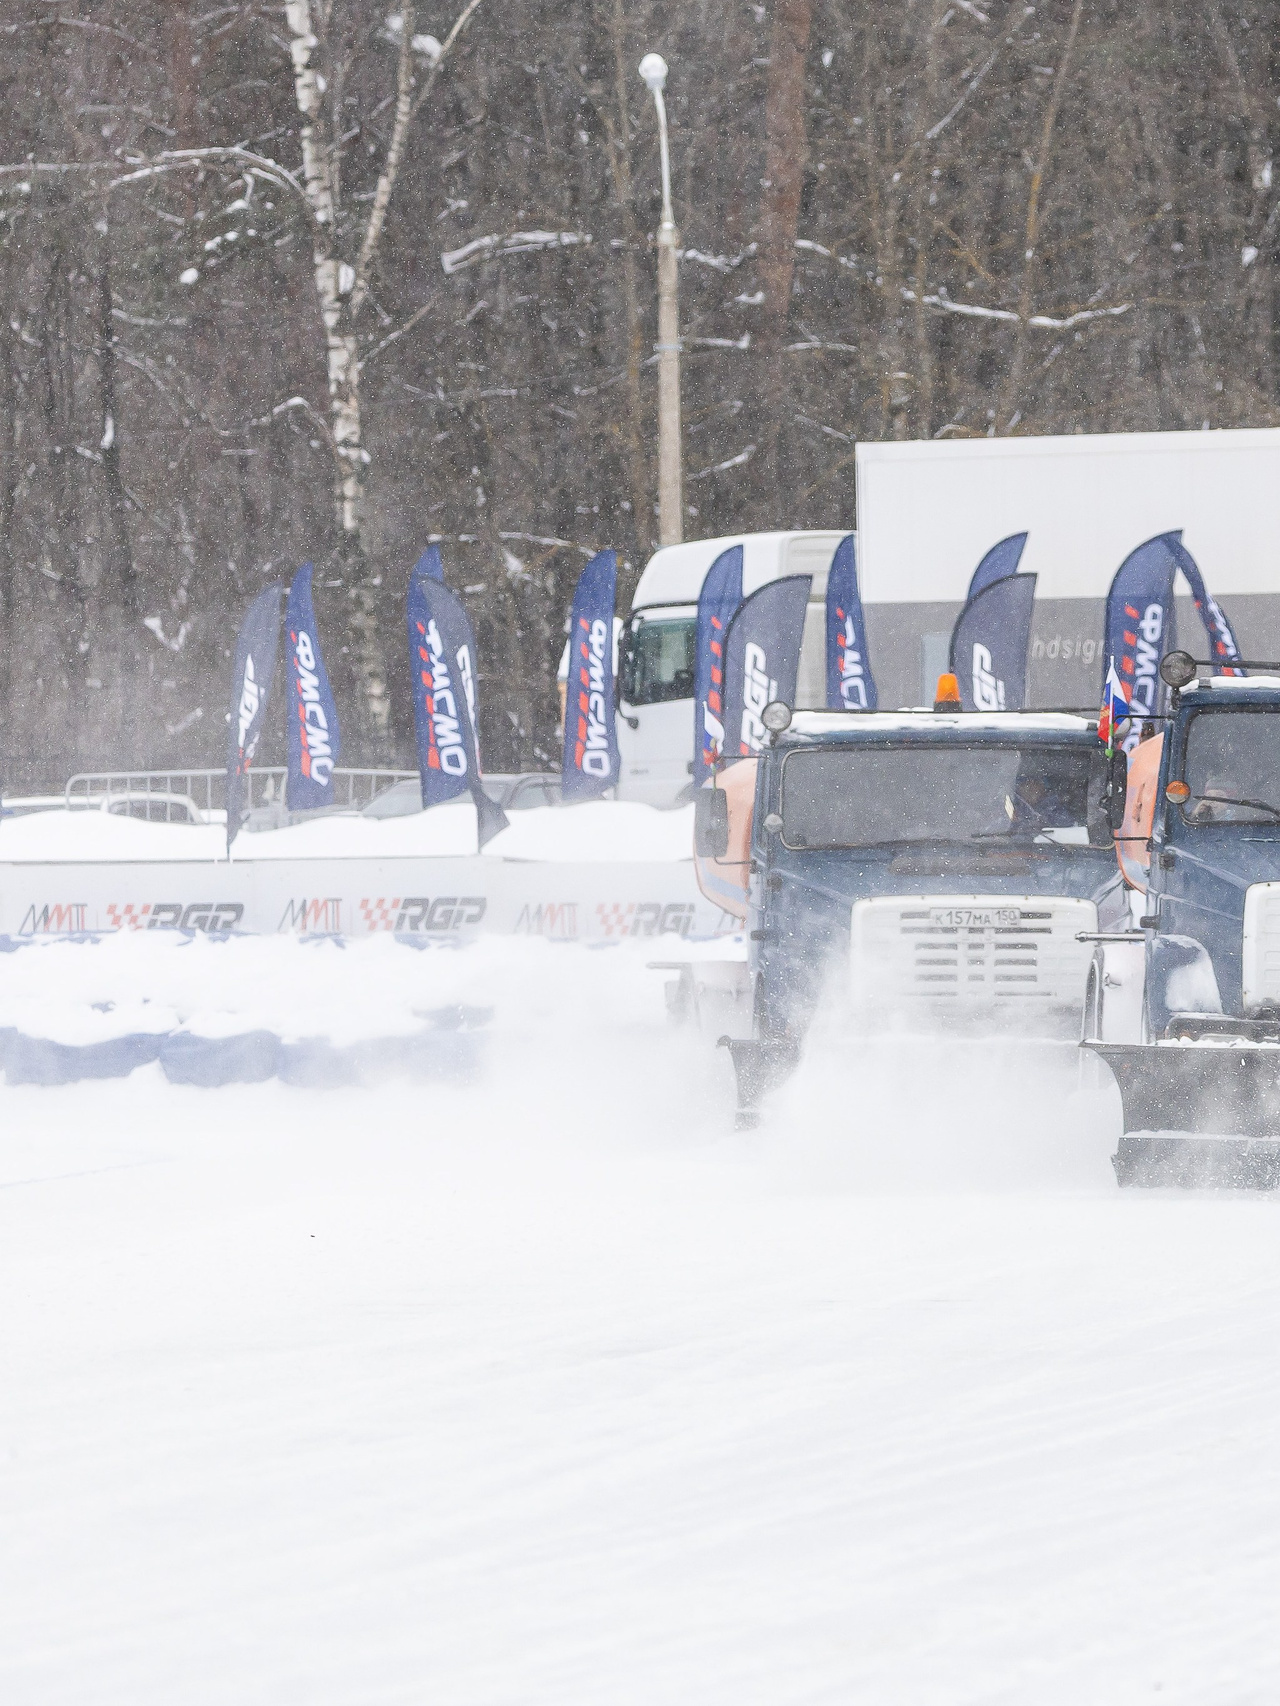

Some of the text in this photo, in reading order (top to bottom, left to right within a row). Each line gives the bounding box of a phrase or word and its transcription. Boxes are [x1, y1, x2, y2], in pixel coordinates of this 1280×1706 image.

[972, 643, 998, 711] GP
[149, 903, 243, 931] RGP
[395, 897, 487, 931] RGP
